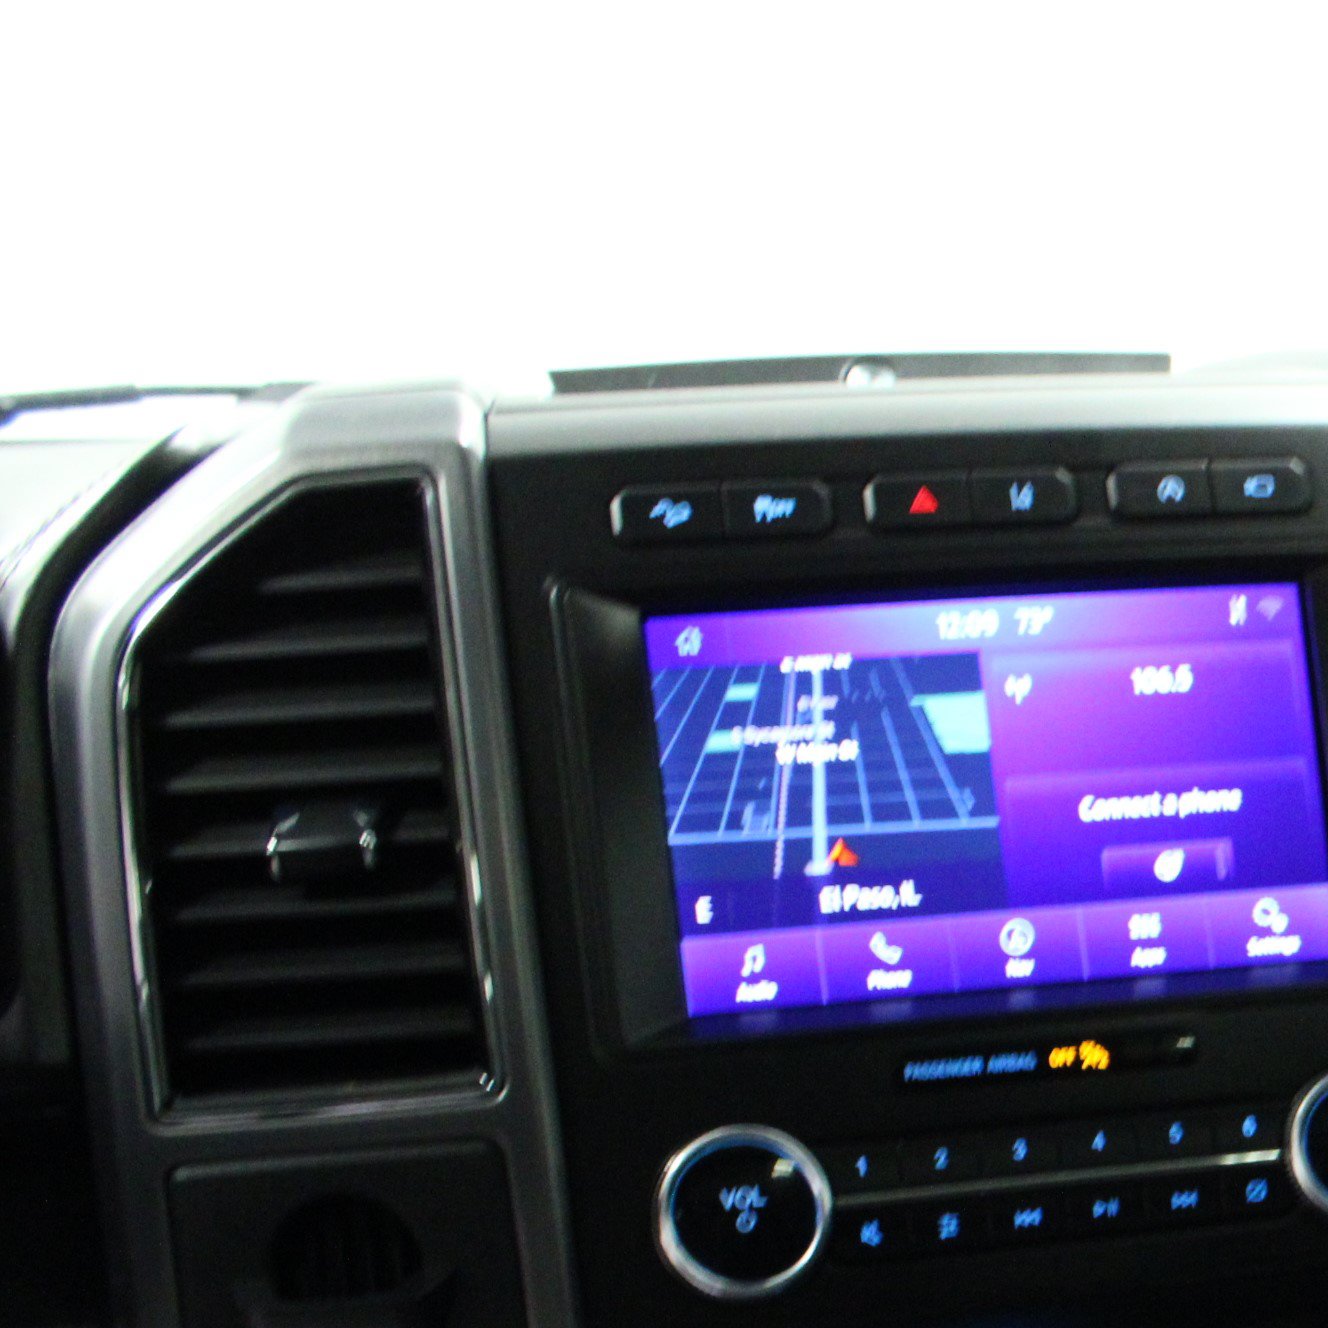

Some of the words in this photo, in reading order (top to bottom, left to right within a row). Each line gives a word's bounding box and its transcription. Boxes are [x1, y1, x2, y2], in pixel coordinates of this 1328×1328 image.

[1078, 791, 1161, 823] Connect
[1178, 786, 1242, 818] phone
[719, 1184, 768, 1212] VOL
